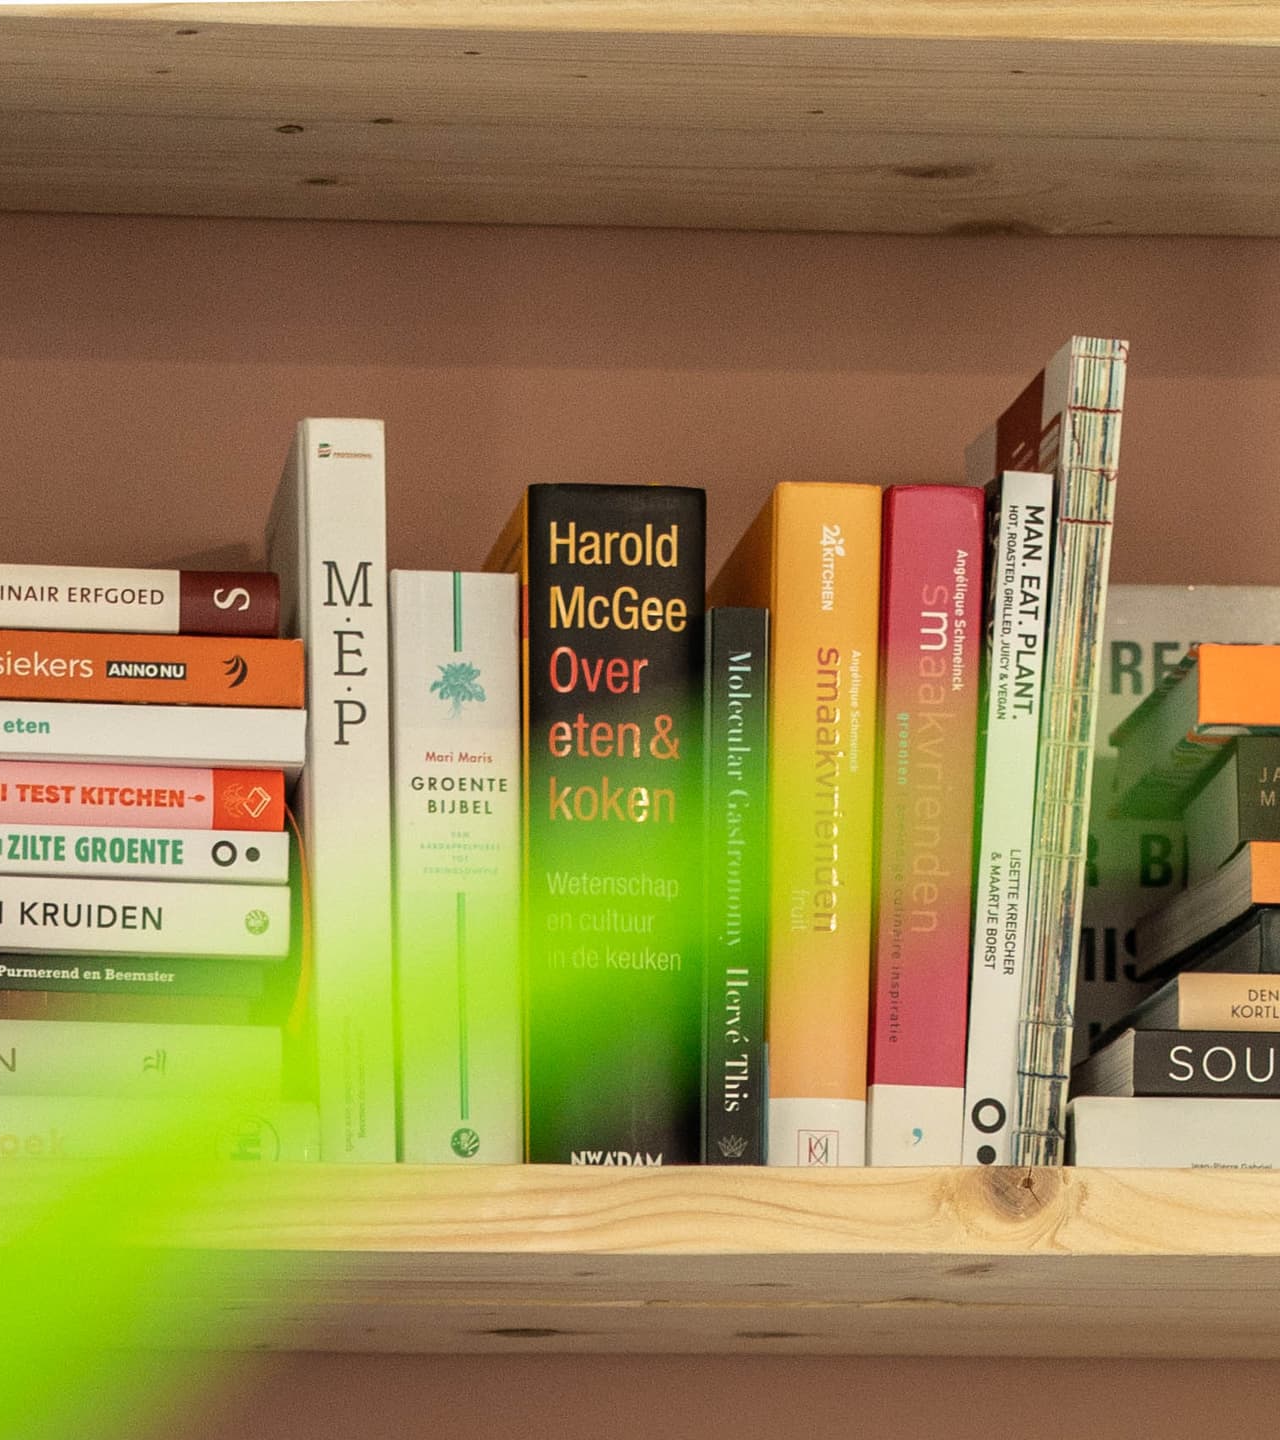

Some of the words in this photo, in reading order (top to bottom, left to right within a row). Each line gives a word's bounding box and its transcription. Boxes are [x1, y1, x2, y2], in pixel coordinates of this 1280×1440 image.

[1008, 504, 1019, 529] HOT,
[1021, 504, 1045, 568] MAN.
[549, 521, 679, 568] Harold
[1004, 532, 1017, 586] ROASTED,
[68, 586, 164, 606] ERFGOED
[952, 549, 969, 615] Angélique
[1017, 574, 1041, 626] EAT.
[549, 585, 688, 632] McGee
[1001, 588, 1014, 639] GRILLED,
[549, 646, 649, 695] Over
[951, 616, 966, 692] Schmeinck
[999, 639, 1011, 673] JUICY
[1012, 632, 1038, 720] PLANT.
[848, 650, 862, 708] Angélique
[995, 682, 1009, 720] VEGAN
[3, 716, 51, 735] eten
[548, 712, 641, 759] eten
[649, 714, 680, 760] &
[727, 651, 753, 782] Molecular
[425, 751, 454, 764] Mari
[458, 751, 494, 764] Maris
[896, 711, 911, 786] groenten
[911, 584, 956, 932] smaakvrienden
[16, 782, 76, 805] TEST
[81, 786, 185, 809] KITCHEN
[411, 776, 509, 793] GROENTE
[427, 799, 494, 815] BIJBEL
[549, 776, 676, 824] koken
[813, 647, 845, 934] smaakvrienden
[7, 834, 66, 862] ZILTE
[75, 836, 184, 866] GROENTE
[720, 788, 750, 946] Gastronomy
[991, 852, 1002, 861] &
[547, 871, 680, 902] Wetenschap
[986, 865, 1001, 925] MAARTJE
[1006, 849, 1022, 900] LISETTE
[20, 901, 163, 930] KRUIDEN
[547, 912, 572, 932] en
[579, 908, 656, 934] cultuur
[791, 889, 810, 932] fruit
[889, 888, 906, 959] culinaire
[547, 948, 565, 968] in
[571, 946, 598, 969] de
[605, 946, 682, 972] keuken
[984, 927, 998, 970] BORST
[1003, 902, 1019, 975] KREISCHER
[82, 969, 102, 981] en
[104, 967, 175, 984] Beemster
[725, 968, 750, 1044] Hervé
[888, 965, 902, 1044] inspiratie
[724, 1053, 749, 1113] This
